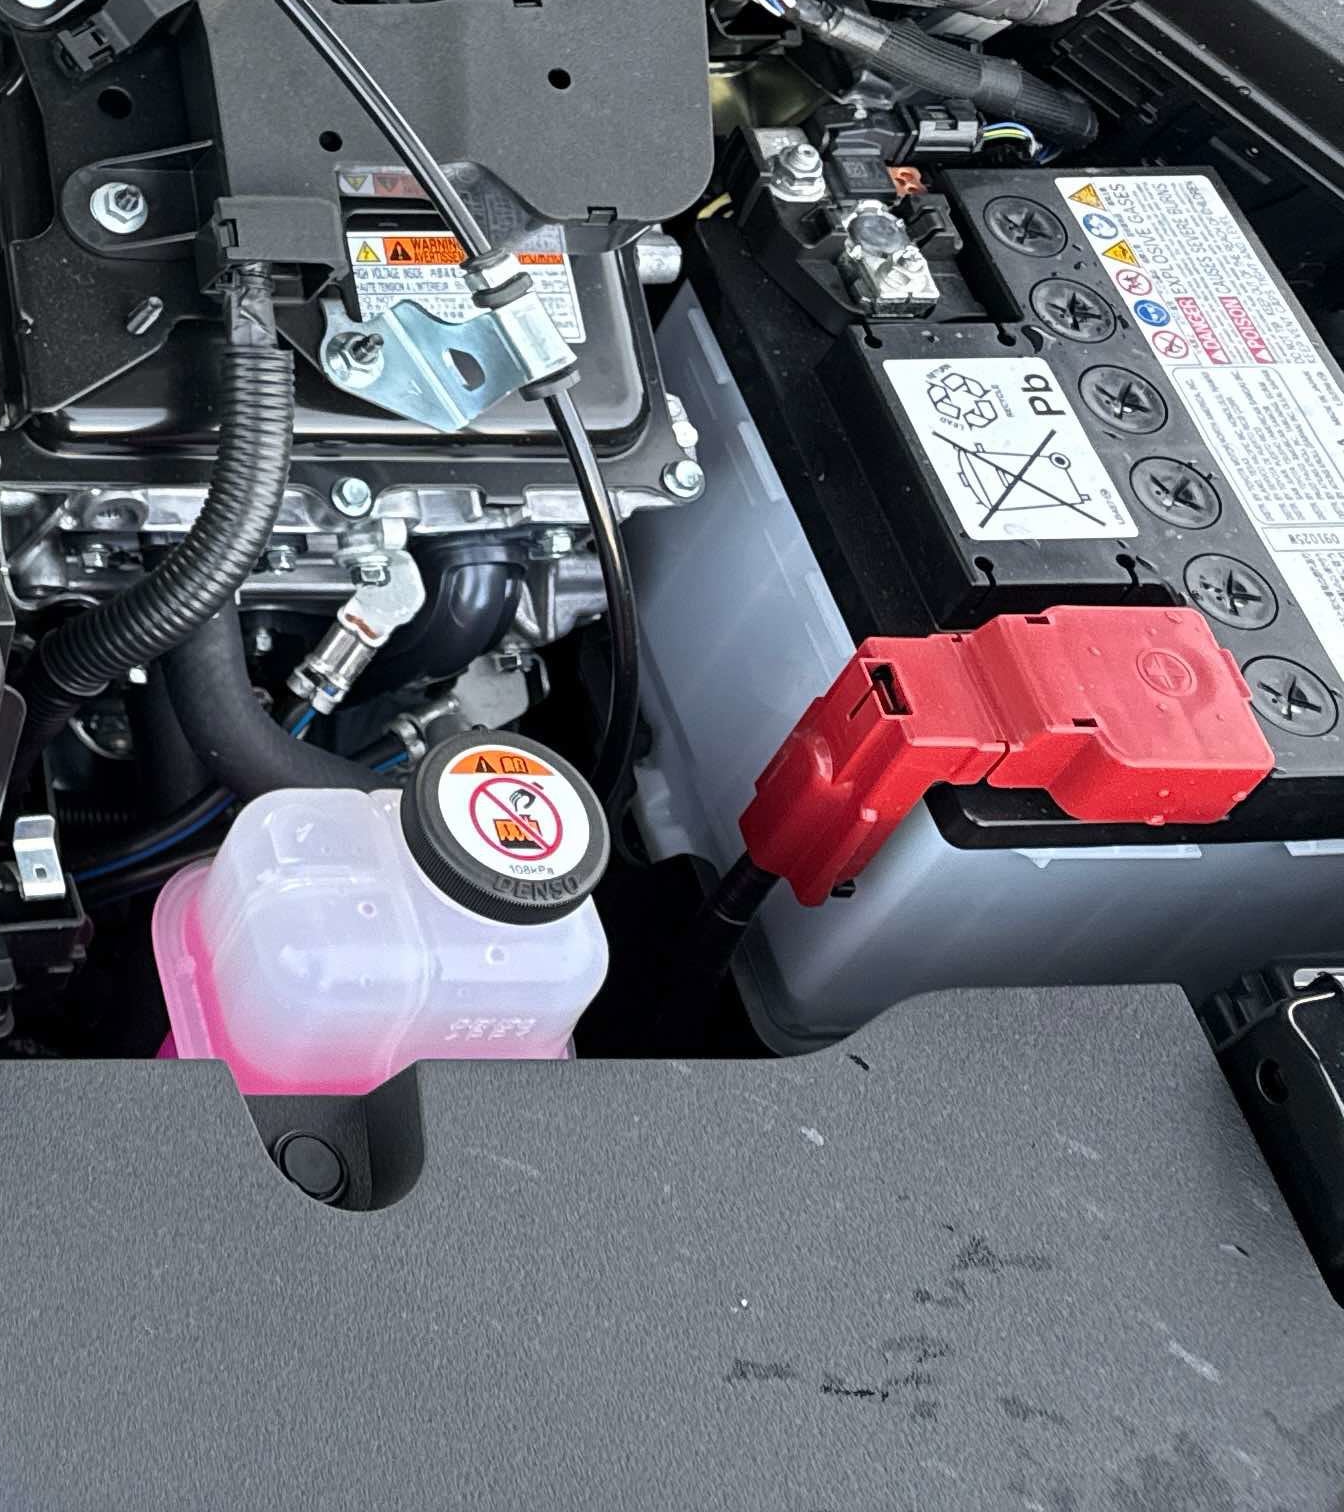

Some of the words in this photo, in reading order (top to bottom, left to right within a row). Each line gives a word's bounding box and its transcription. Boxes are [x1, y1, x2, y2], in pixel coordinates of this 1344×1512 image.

[1108, 182, 1144, 224] GASES
[1151, 182, 1183, 215] BURNS
[412, 239, 460, 249] WARNIN
[1172, 217, 1206, 254] SEVERE
[1135, 226, 1186, 295] EXPLOSIVE
[1196, 255, 1231, 294] CAUSES
[1177, 297, 1220, 350] DANGER
[1222, 298, 1265, 349] POISON
[1020, 372, 1065, 418] Pb
[492, 874, 581, 901] DENSO
[509, 864, 555, 875] 108kPa
